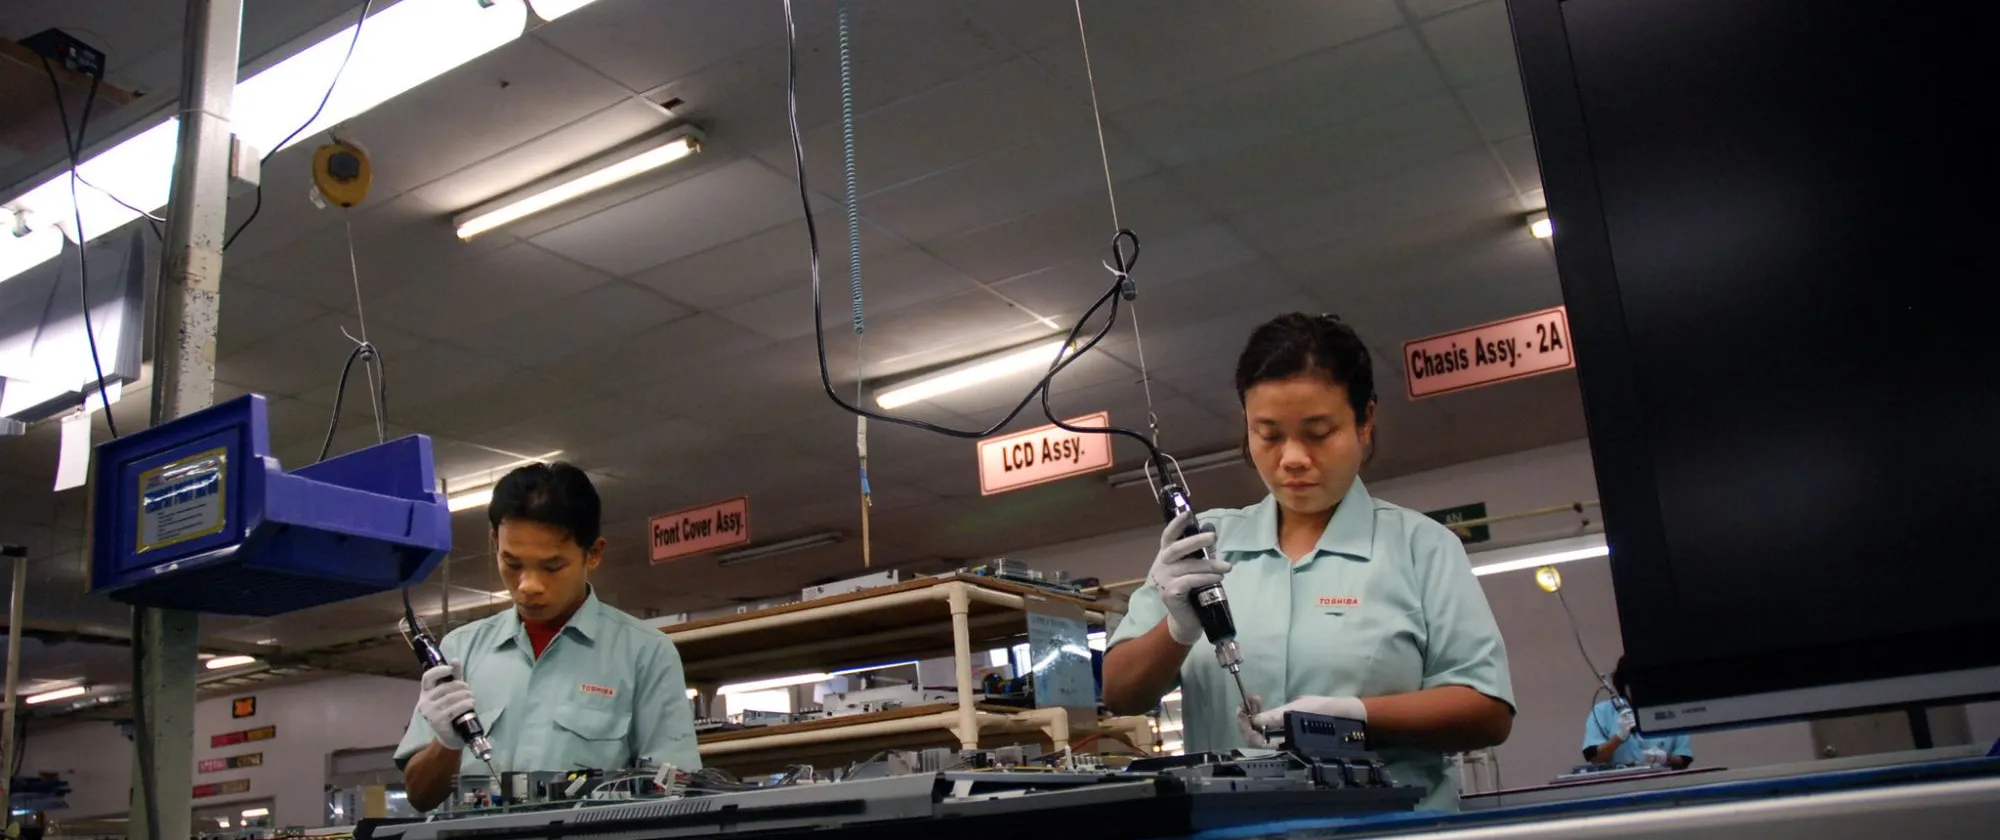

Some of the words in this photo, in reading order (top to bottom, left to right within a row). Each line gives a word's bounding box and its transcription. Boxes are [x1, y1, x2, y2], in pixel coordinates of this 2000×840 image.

[1411, 342, 1470, 380] Chasis
[1475, 336, 1522, 368] Assy.
[1536, 320, 1563, 354] 2A
[1003, 441, 1034, 472] LCD
[1042, 437, 1084, 464] Assy.
[654, 521, 680, 548] Front
[683, 517, 711, 541] Cover
[716, 509, 744, 536] Assy.
